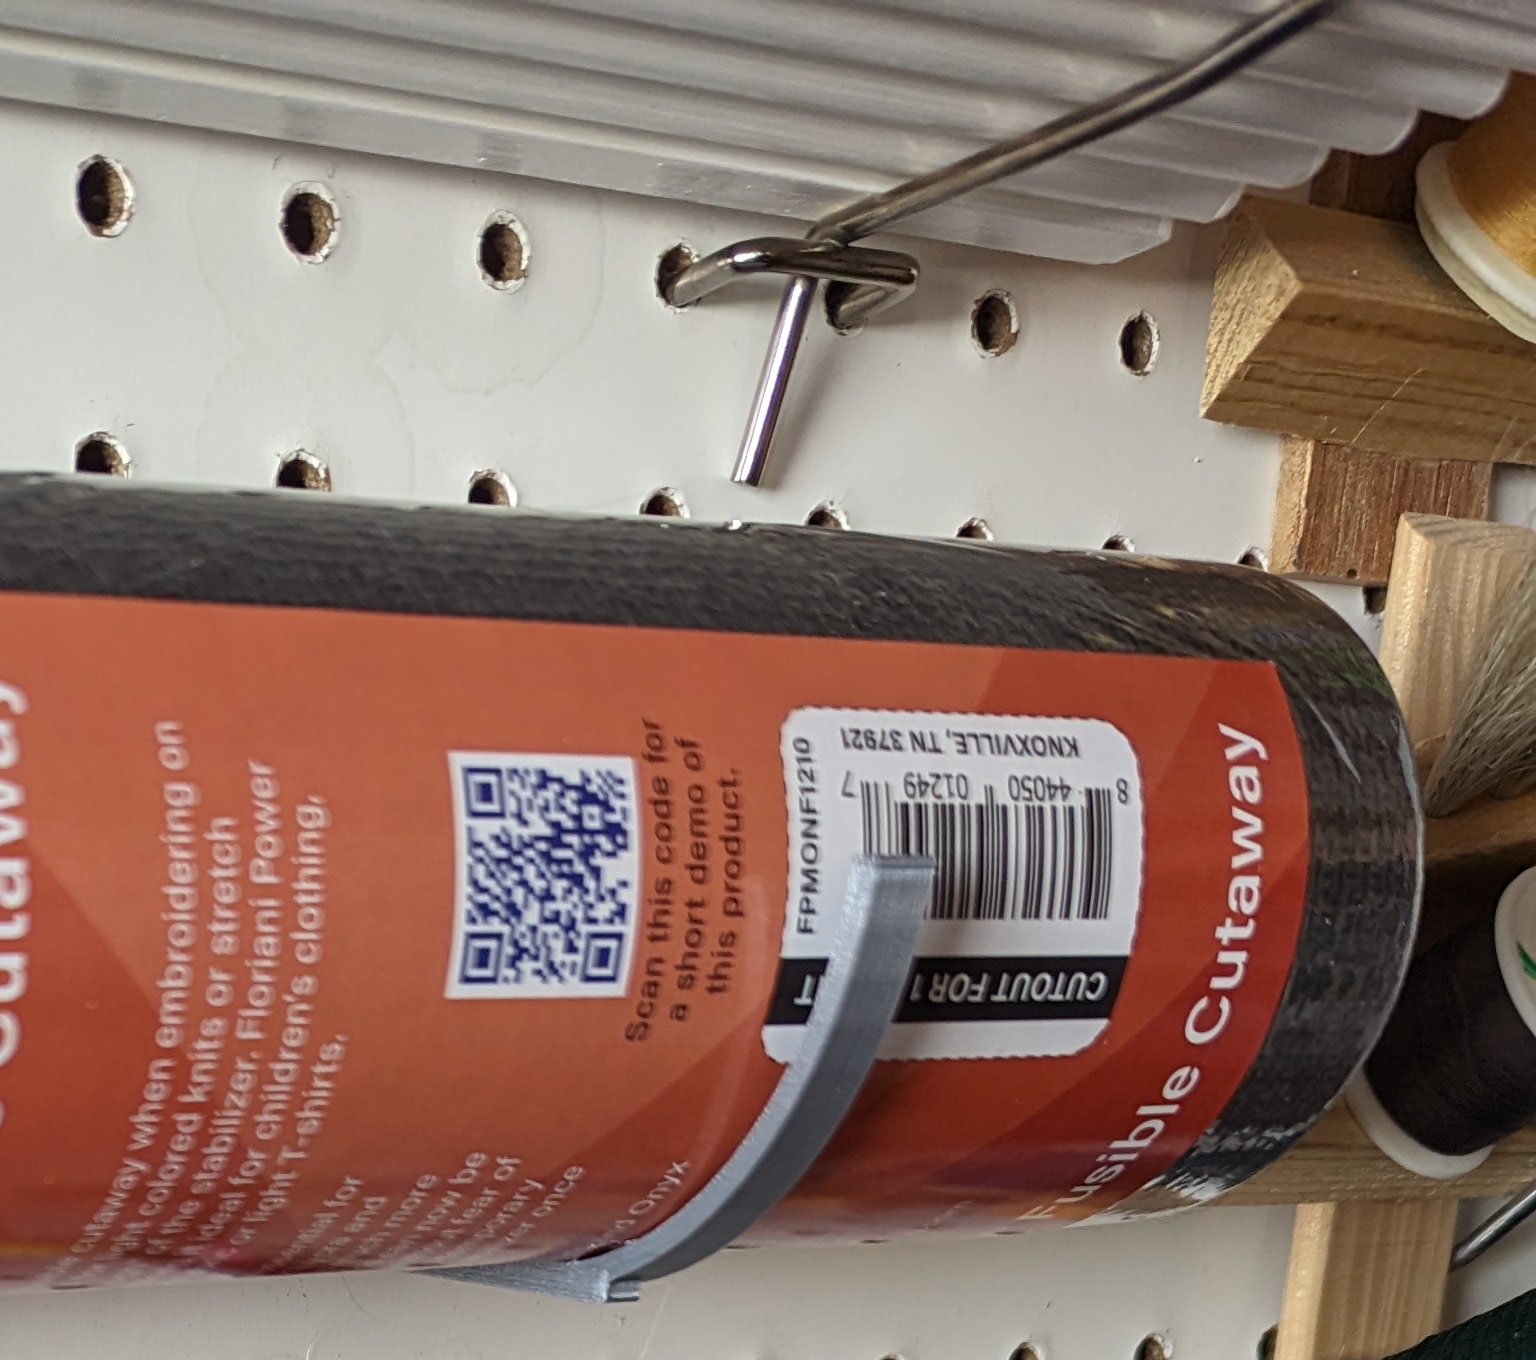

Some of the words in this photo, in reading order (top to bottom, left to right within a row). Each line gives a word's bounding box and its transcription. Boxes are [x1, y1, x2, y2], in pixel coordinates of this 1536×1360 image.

[154, 718, 190, 769] on
[639, 715, 668, 764] for
[673, 736, 702, 771] of
[839, 725, 906, 752] 37921
[908, 728, 943, 753] TN
[945, 726, 1083, 758] KNOXVILLE,
[840, 768, 862, 797] 7
[902, 769, 970, 799] 01249
[1007, 772, 1074, 801] 44050
[1115, 776, 1132, 803] 8
[247, 756, 284, 883] Power
[647, 774, 675, 864] code
[683, 782, 710, 886] demo
[716, 765, 745, 917] product.
[790, 733, 822, 935] FPMONF1210
[155, 781, 201, 1047] embroidering
[203, 816, 242, 954] stretch
[645, 875, 675, 943] this
[234, 896, 284, 1039] Floriani
[674, 895, 705, 990] short
[704, 928, 737, 994] this
[1014, 1064, 1201, 1219] Fusible
[1183, 721, 1268, 1044] Cutaway
[205, 966, 236, 1006] or
[225, 1146, 269, 1184] for
[251, 974, 318, 1139] children's
[287, 793, 332, 964] clothing,
[624, 955, 666, 1041] Scan
[668, 1001, 691, 1021] a
[928, 971, 989, 1002] FOR
[991, 970, 1110, 1000] CUTOUT
[176, 1016, 229, 1101] knits
[127, 1057, 178, 1149] when
[189, 1049, 264, 1194] stabilizer.
[240, 1169, 302, 1221] light
[275, 1031, 351, 1165] T-shirts.
[137, 1109, 206, 1215] colored
[321, 1174, 364, 1207] for
[415, 1188, 463, 1231] now
[447, 1150, 488, 1183] be
[450, 1185, 501, 1224] fear
[491, 1154, 524, 1181] of
[531, 1164, 588, 1216] once
[627, 1158, 692, 1215] Onyx
[69, 1156, 152, 1252] cutaway
[158, 1198, 206, 1233] the
[342, 1195, 389, 1233] and
[383, 1172, 439, 1227] more
